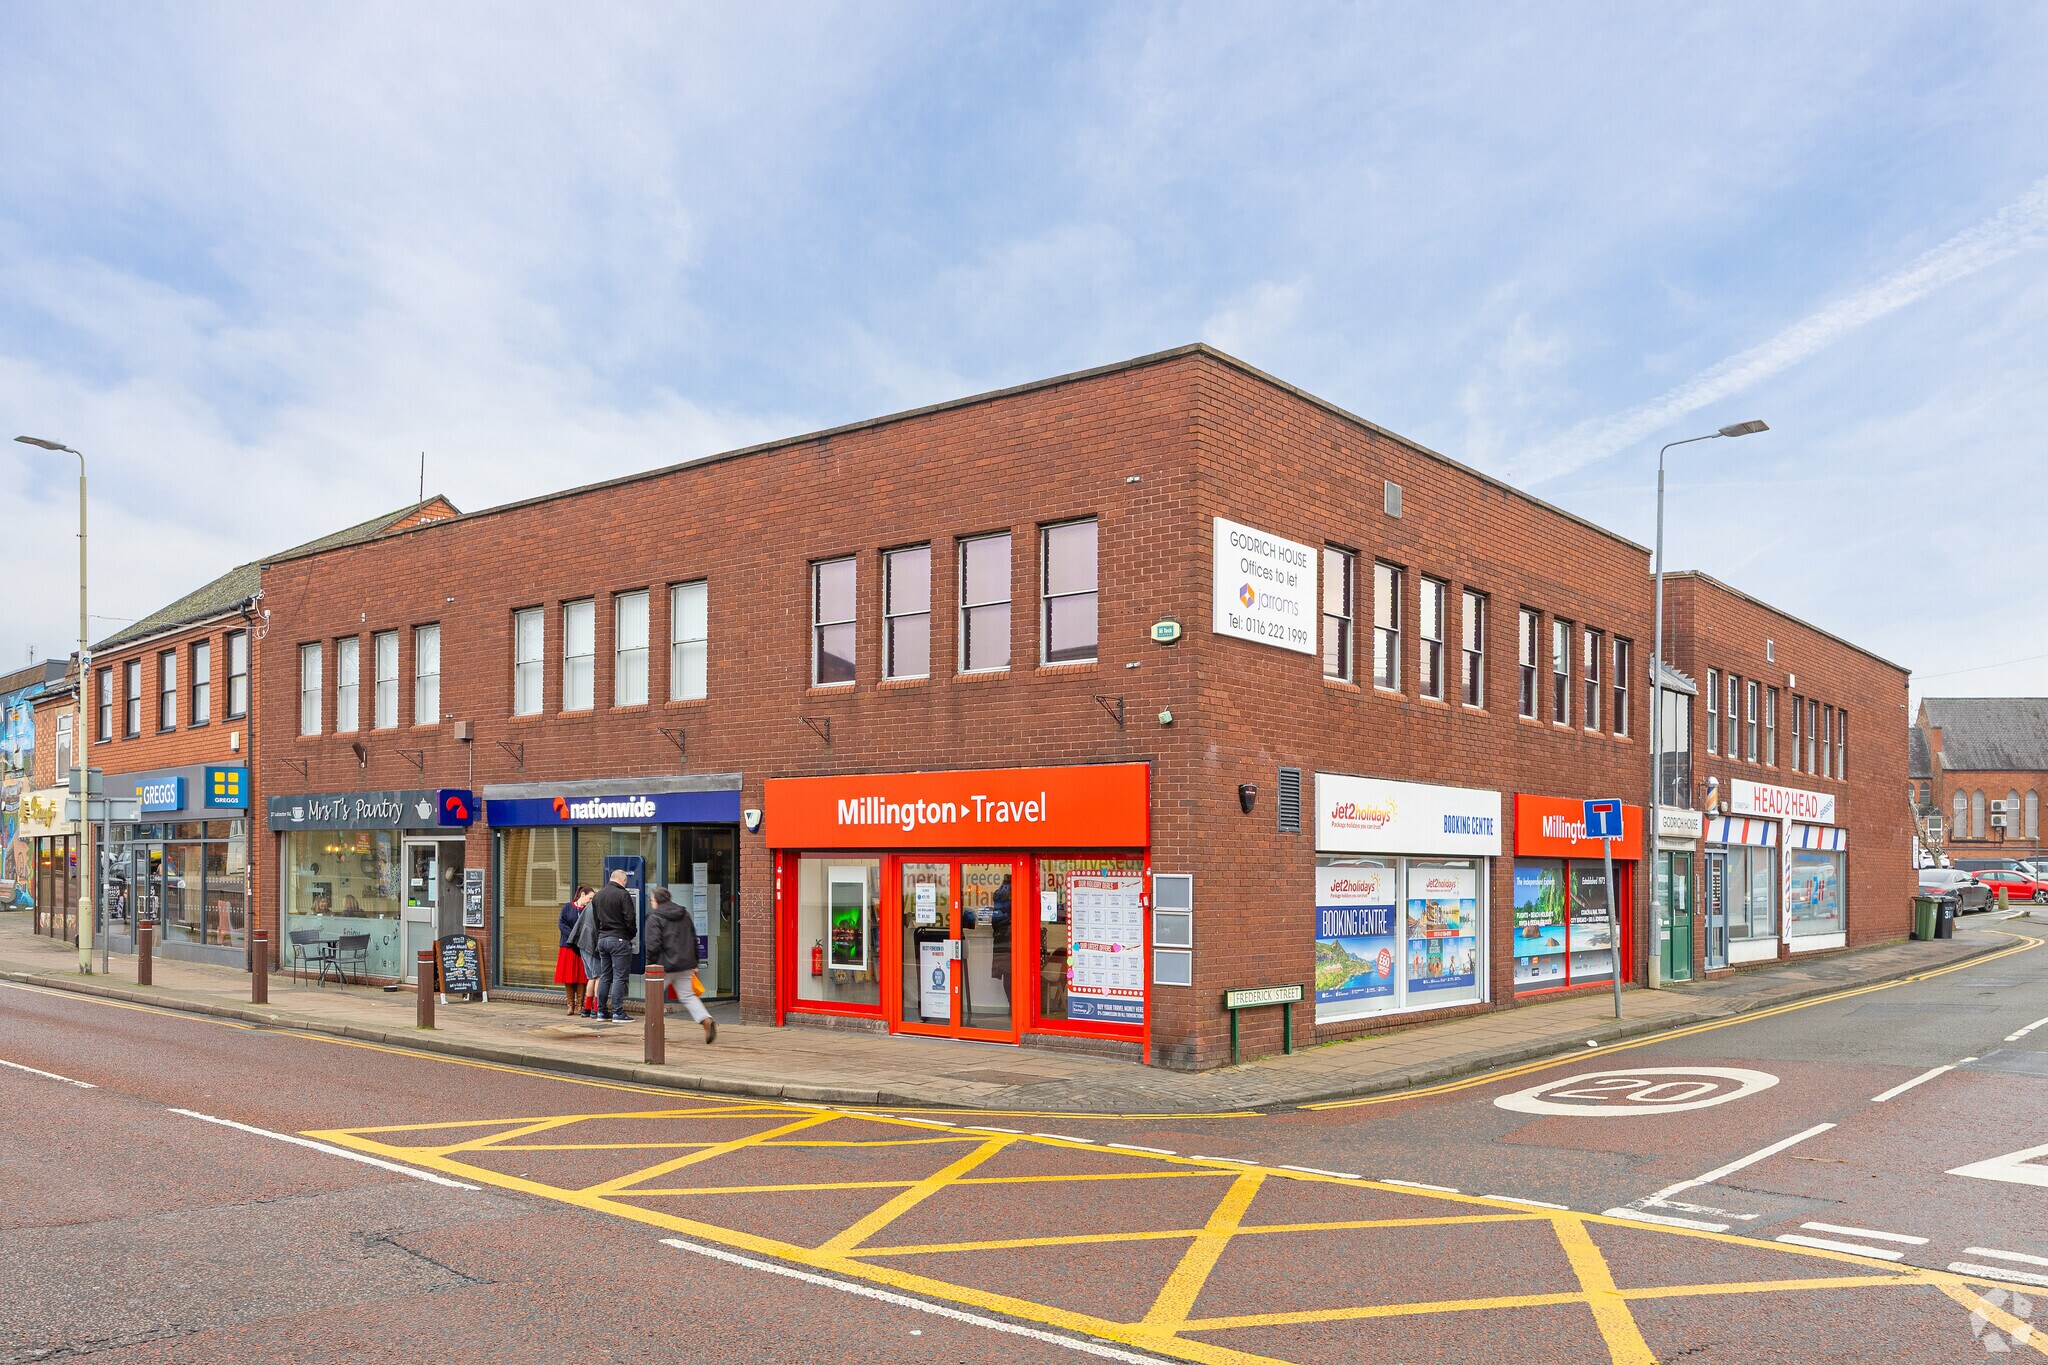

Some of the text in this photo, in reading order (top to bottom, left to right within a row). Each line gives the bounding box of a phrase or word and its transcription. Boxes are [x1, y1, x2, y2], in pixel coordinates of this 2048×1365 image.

[1230, 531, 1307, 569] GODRICH HOUSE
[1240, 558, 1298, 588] Offices to let
[1257, 589, 1299, 616] jarroms
[1228, 612, 1308, 645] Tel: 0116 222 1999
[143, 784, 175, 805] GREGGS
[308, 797, 404, 824] Mrs T's Pantry
[570, 796, 656, 819] nationwide
[837, 791, 1046, 832] Millington Travel
[1331, 802, 1391, 826] Jet2holidays
[1443, 814, 1494, 836] BOOKING CENTRE
[1542, 815, 1589, 845] Millingto
[1662, 815, 1698, 830] GODRICH HOUSE
[1087, 881, 1102, 889] HOLIDAY
[1102, 882, 1114, 890] DEALS
[1330, 879, 1375, 895] Jet2holidays
[1426, 879, 1456, 891] Jet2holidays
[1523, 877, 1543, 887] Independent
[1582, 877, 1598, 885] Established
[1322, 908, 1388, 937] BOOKING CENTRE
[1099, 944, 1112, 952] OFFERS
[1378, 953, 1390, 967] £60
[1236, 987, 1299, 1004] FREDERICK STREET
[1549, 1078, 1719, 1102] 20
